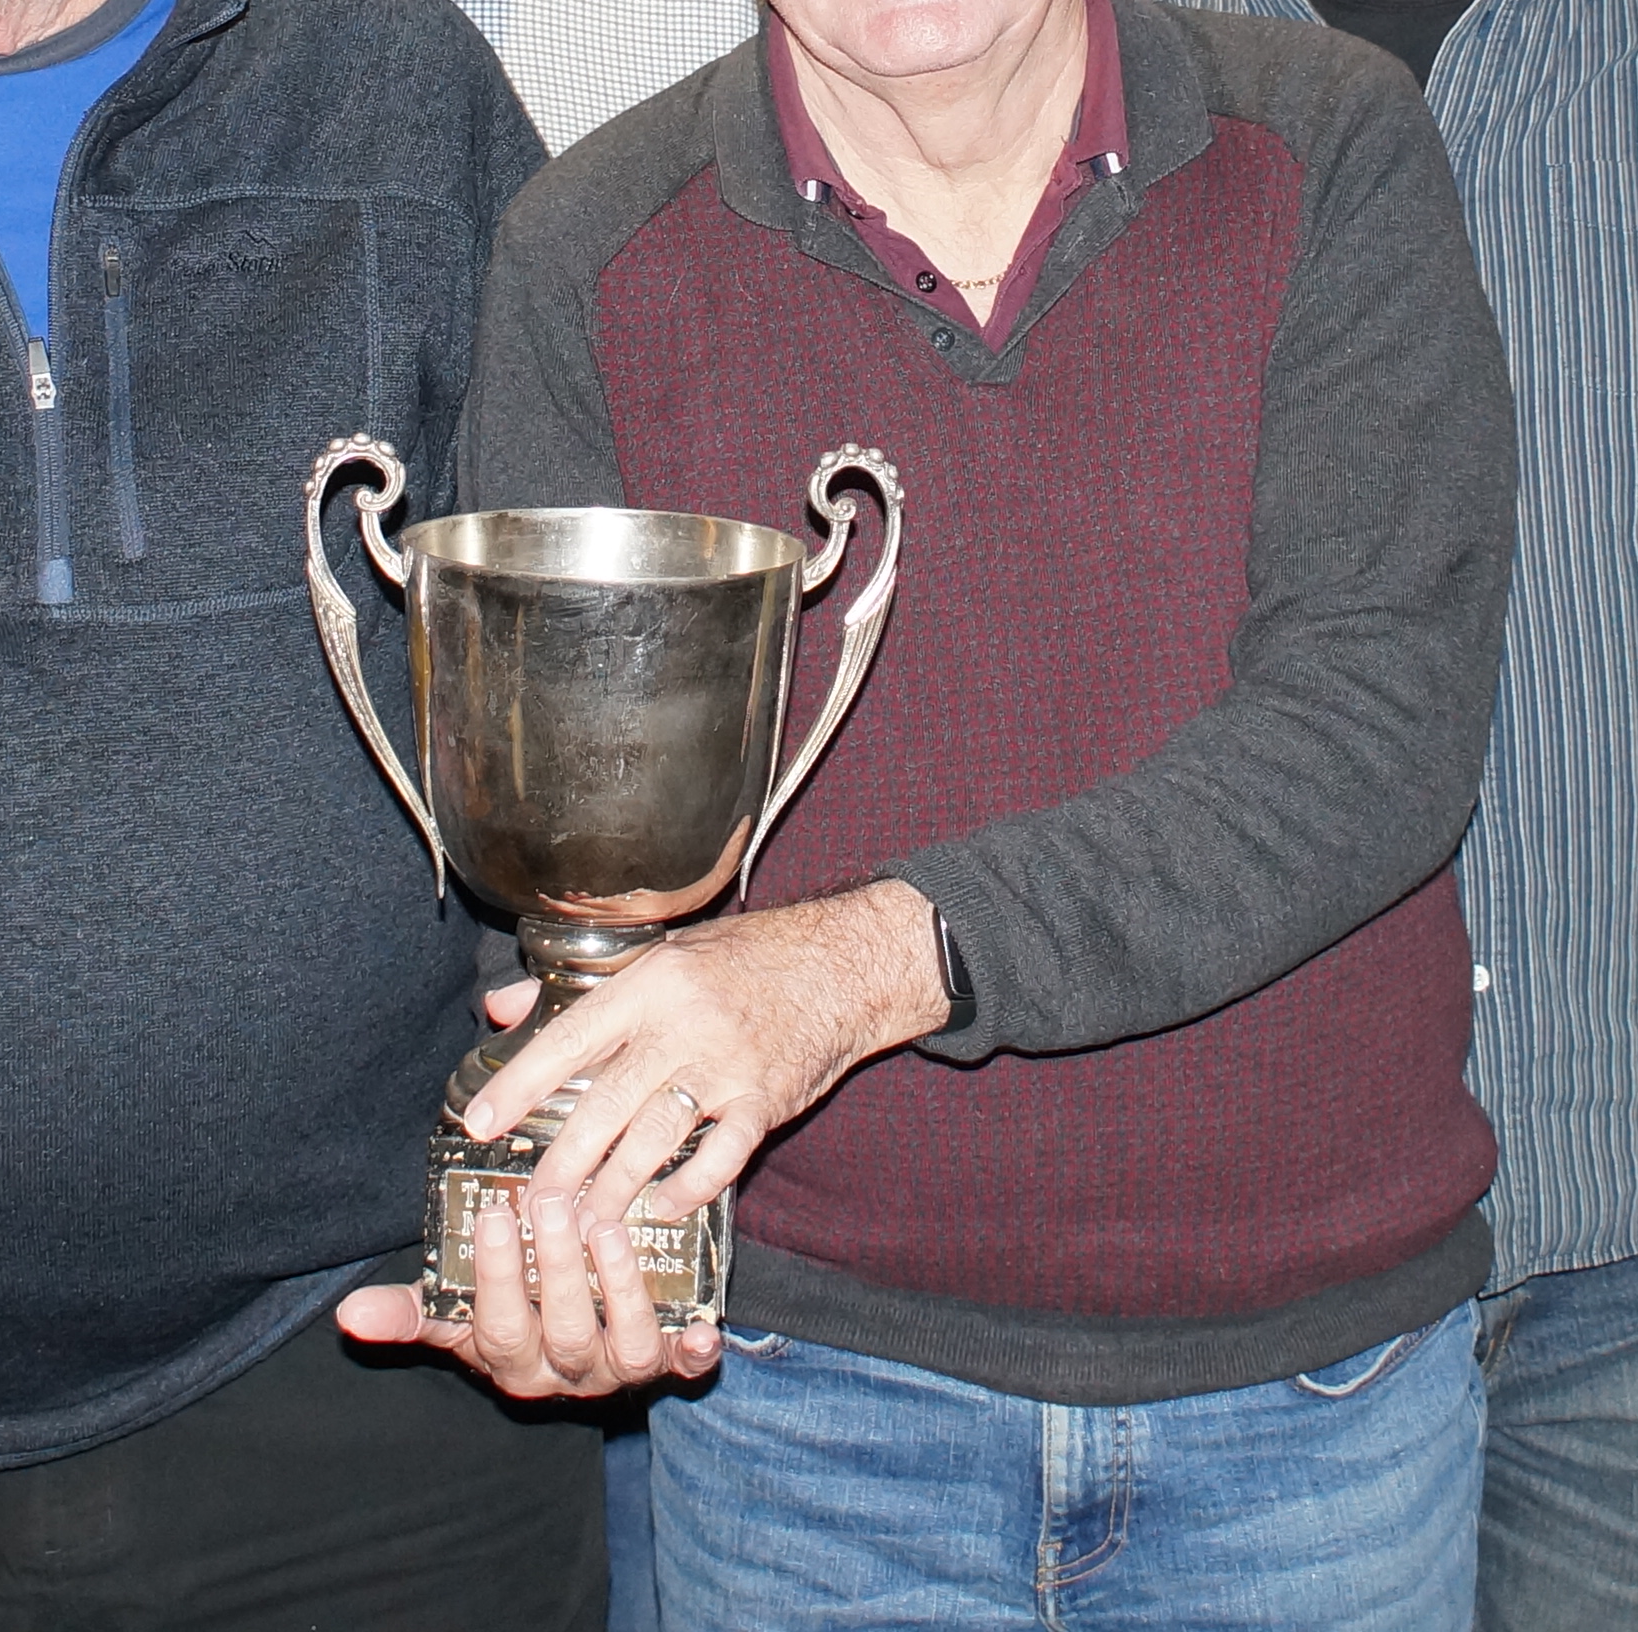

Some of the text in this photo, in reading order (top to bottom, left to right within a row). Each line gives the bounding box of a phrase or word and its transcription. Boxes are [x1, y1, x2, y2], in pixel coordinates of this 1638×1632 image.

[461, 1180, 510, 1209] THE
[627, 1226, 685, 1249] OPHY
[638, 1256, 684, 1274] EAGUE
